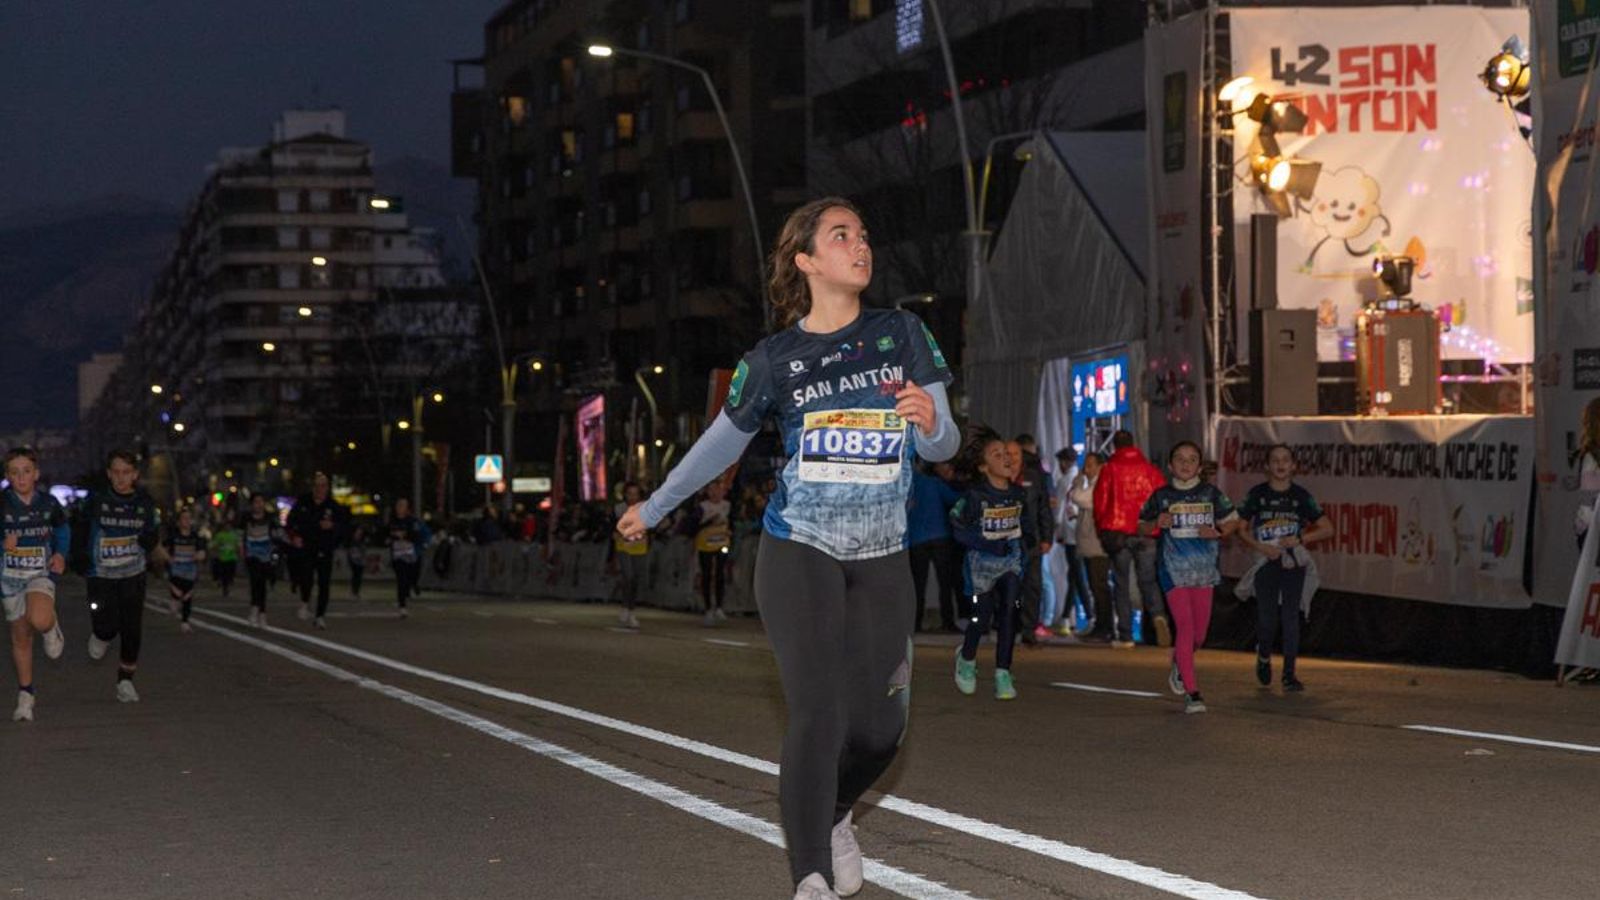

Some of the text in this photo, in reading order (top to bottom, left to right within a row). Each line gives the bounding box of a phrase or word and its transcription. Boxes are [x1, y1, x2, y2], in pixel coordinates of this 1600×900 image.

[1271, 44, 1436, 88] 42 SAN
[792, 380, 833, 407] SAN
[839, 363, 903, 393] ANTÓN
[805, 429, 901, 456] 10837
[1334, 441, 1441, 478] INTERNACIONAL
[1444, 442, 1495, 481] NOCHE
[1497, 441, 1519, 481] DE
[8, 555, 44, 568] 11422
